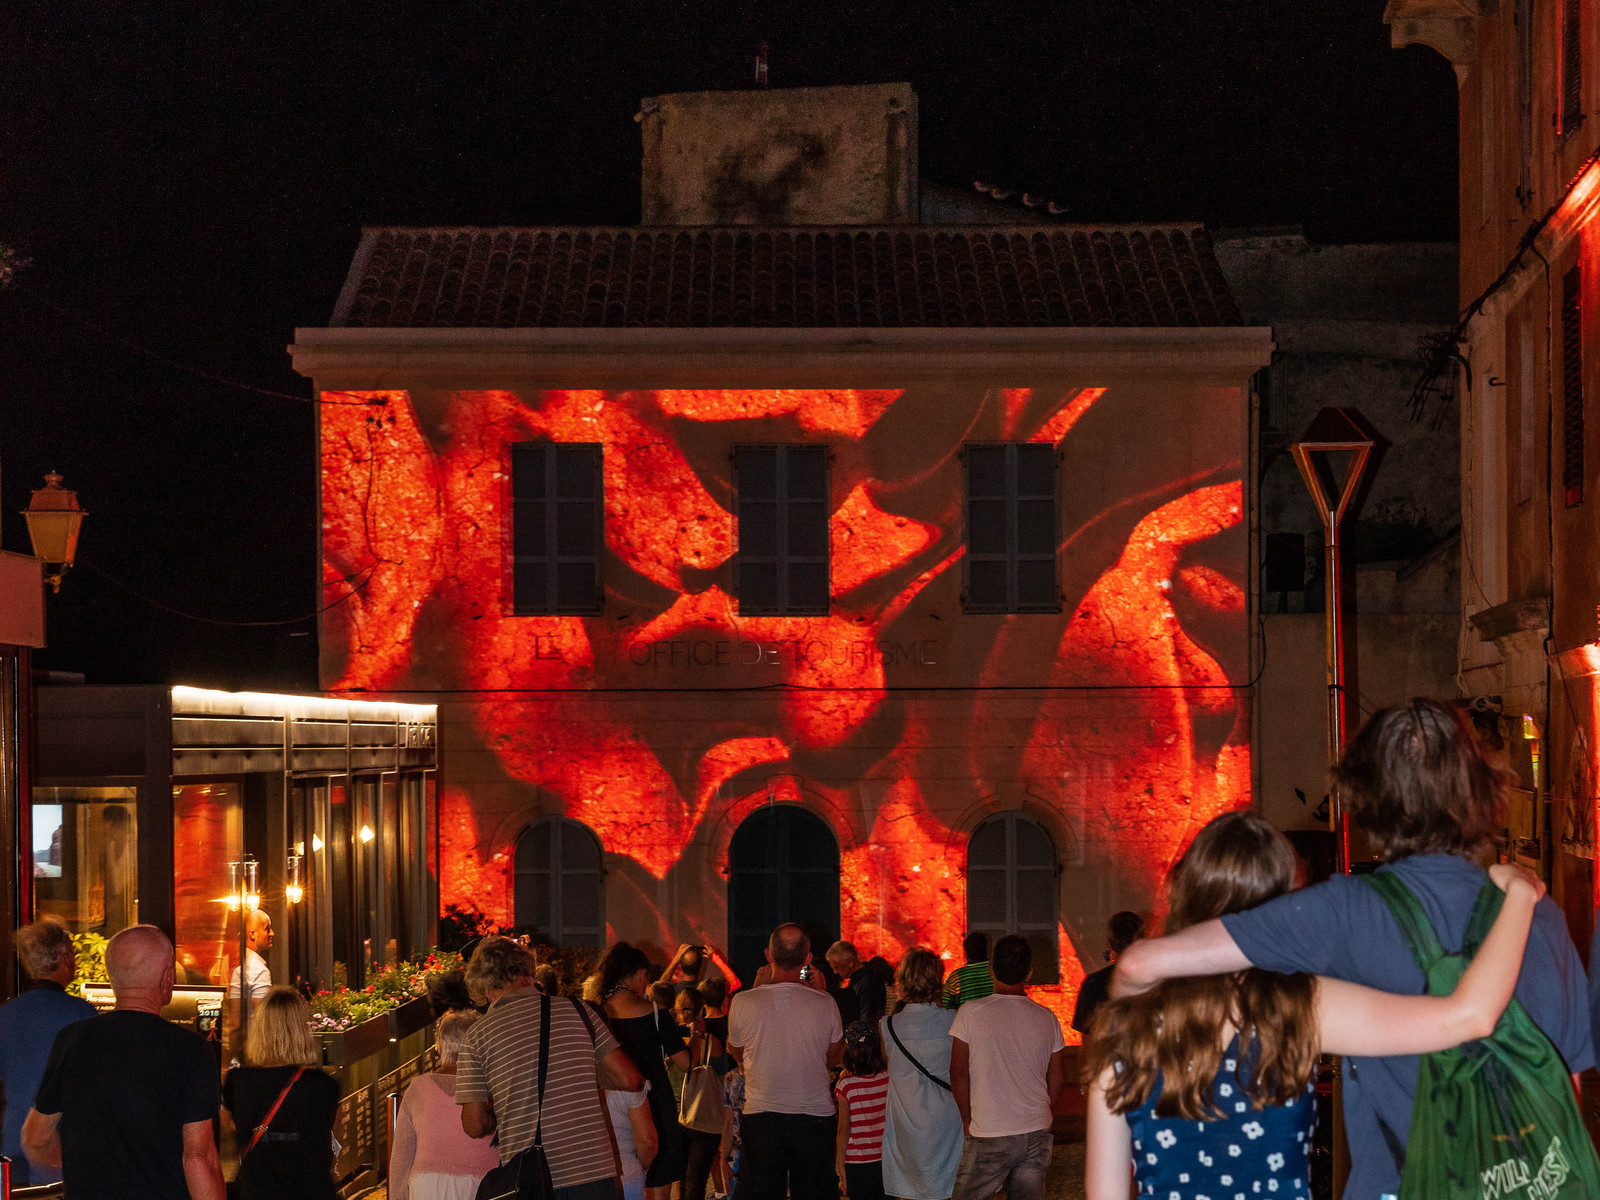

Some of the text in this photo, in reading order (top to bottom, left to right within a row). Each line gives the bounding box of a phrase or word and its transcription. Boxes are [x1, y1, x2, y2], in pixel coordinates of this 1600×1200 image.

[629, 641, 937, 666] OFFICE DE TOURISME
